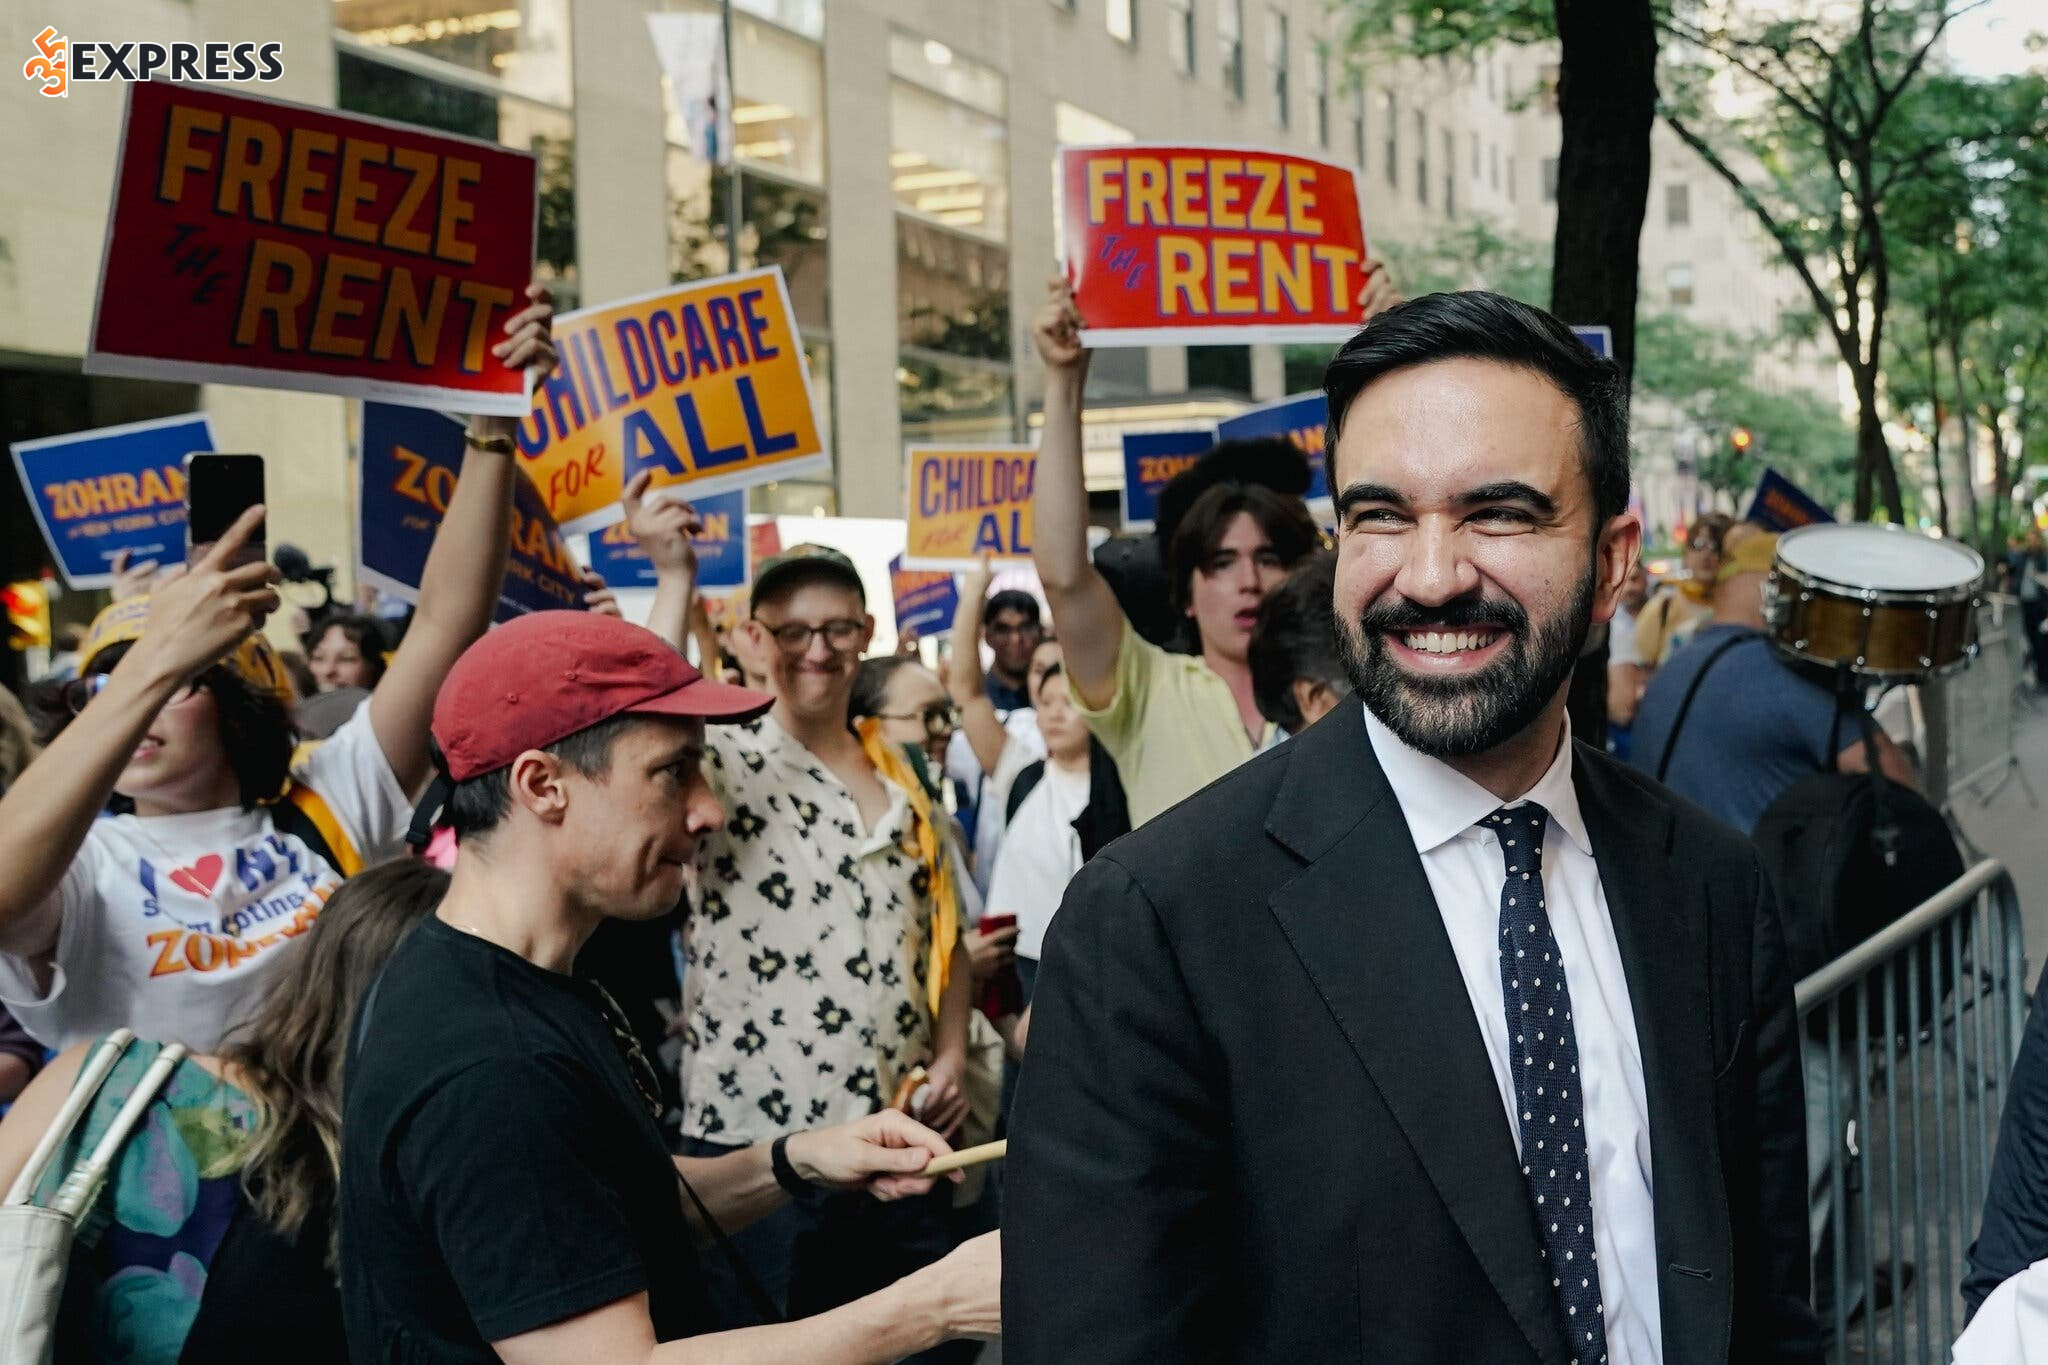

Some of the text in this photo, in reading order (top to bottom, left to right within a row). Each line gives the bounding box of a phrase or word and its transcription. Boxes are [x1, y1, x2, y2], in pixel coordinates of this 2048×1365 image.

[157, 105, 483, 266] FREEZE
[1086, 157, 1324, 235] FREEZE
[165, 223, 232, 305] THE
[1100, 235, 1148, 290] THE
[1157, 235, 1359, 317] RENT
[232, 239, 514, 375] RENT
[550, 375, 798, 512] FOR ALL
